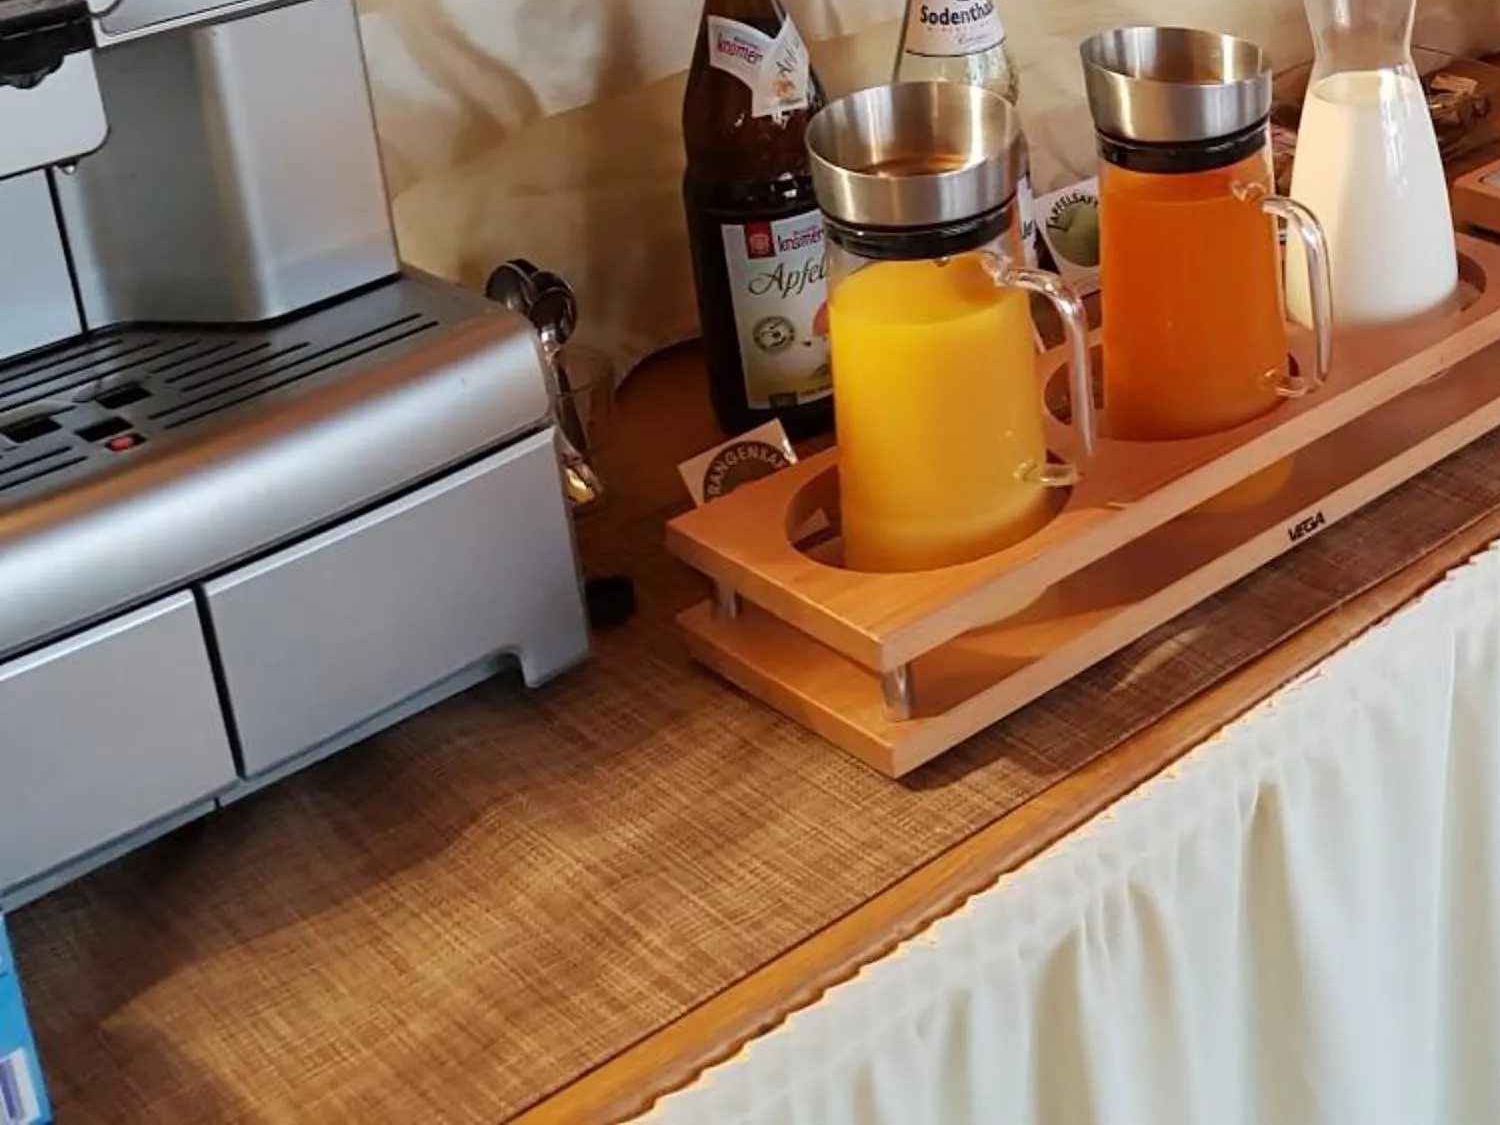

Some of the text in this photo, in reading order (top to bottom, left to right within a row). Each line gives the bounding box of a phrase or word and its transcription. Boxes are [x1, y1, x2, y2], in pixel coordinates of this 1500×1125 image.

[748, 253, 827, 299] Apfel
[707, 445, 787, 495] RANGENSAF
[1287, 510, 1326, 542] VEGA
